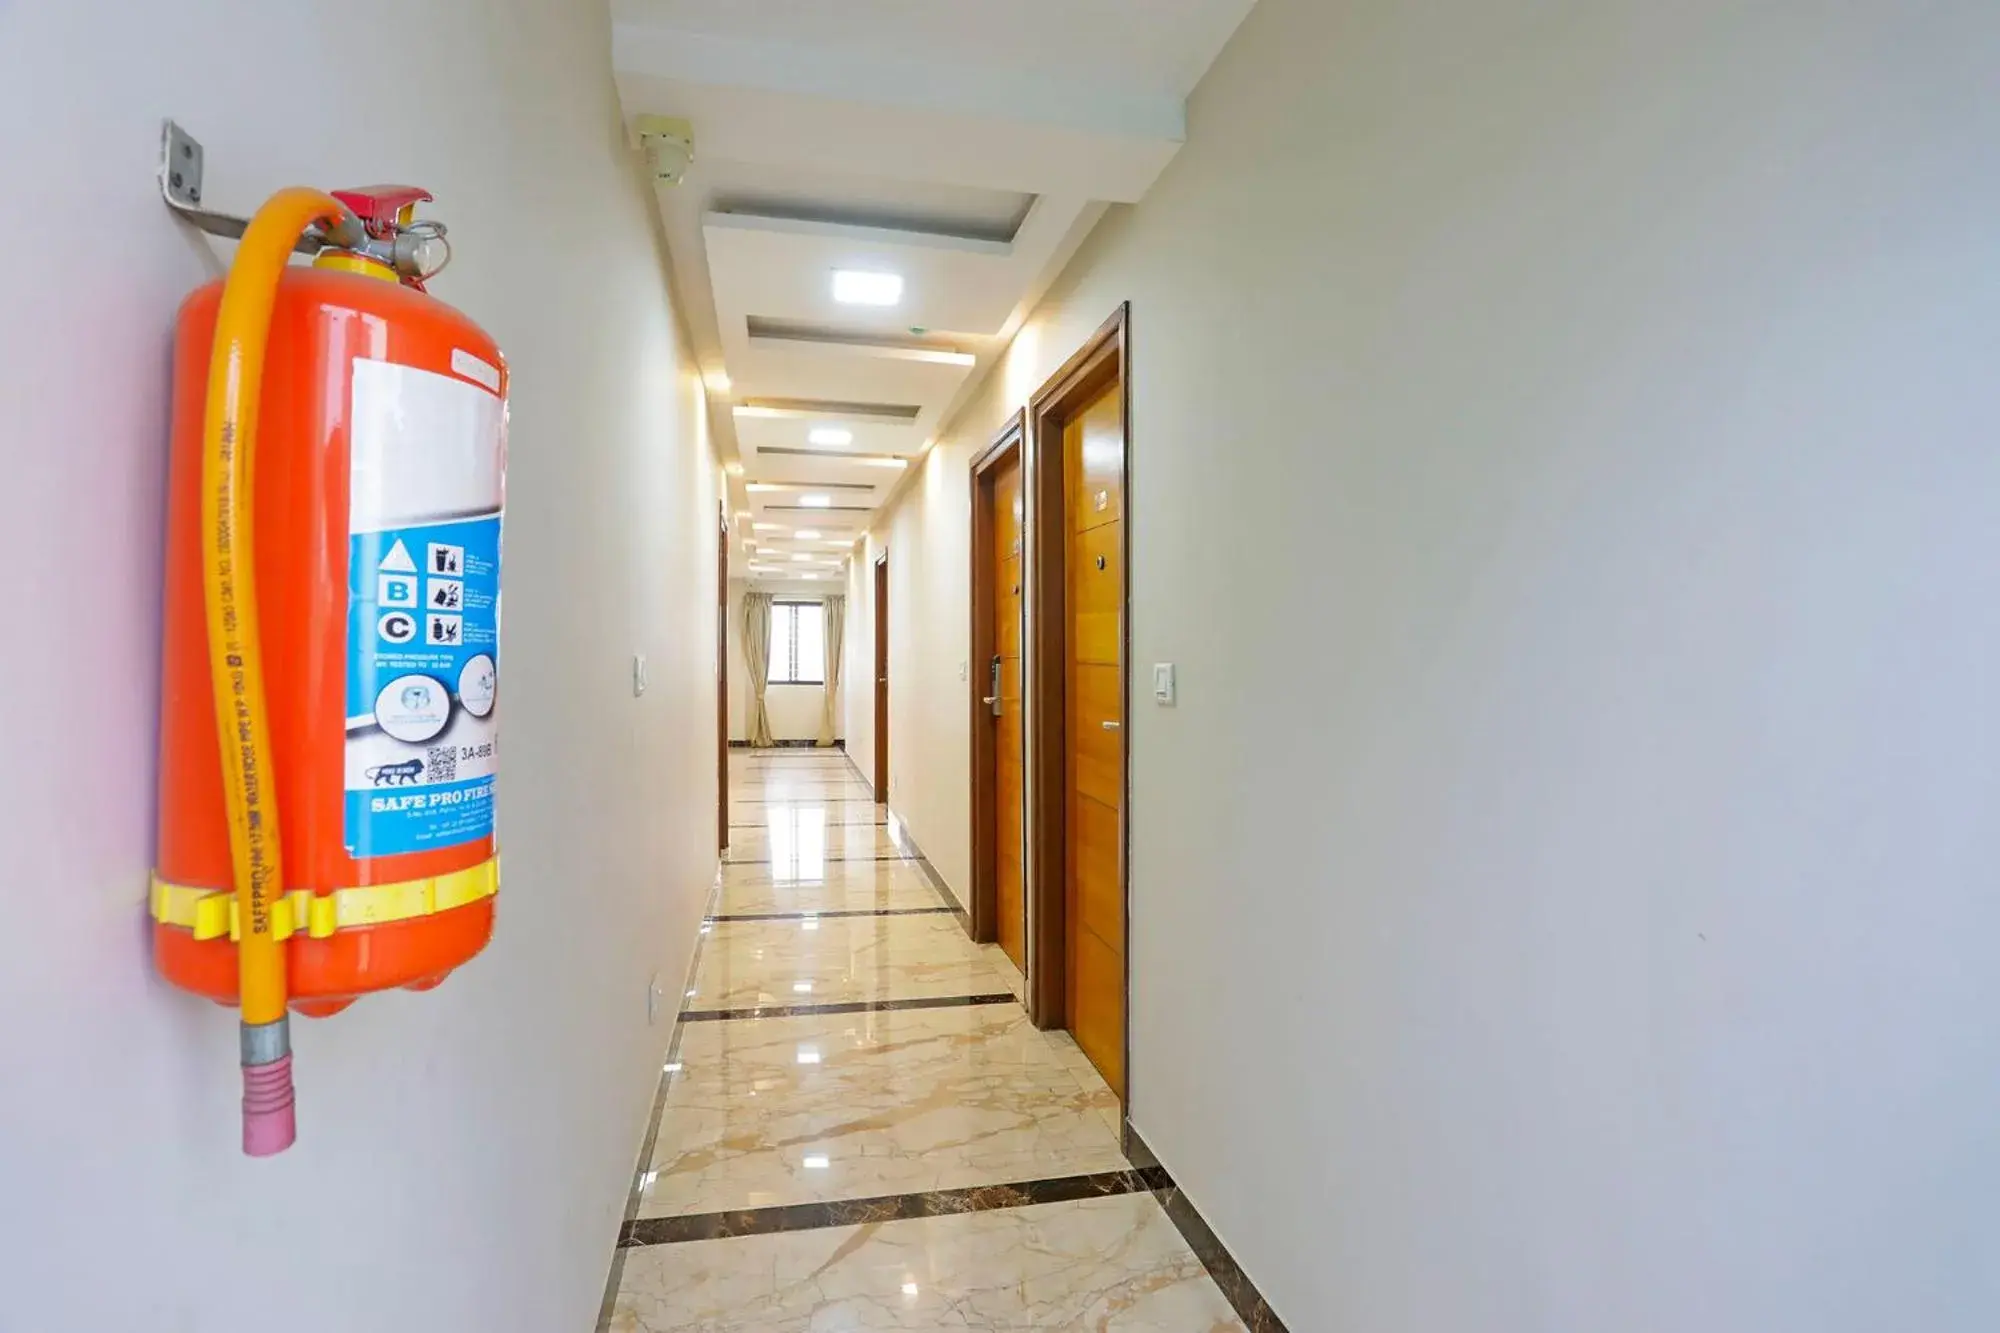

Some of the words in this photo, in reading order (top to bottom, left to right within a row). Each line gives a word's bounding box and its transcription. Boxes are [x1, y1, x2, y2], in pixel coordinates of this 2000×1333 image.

[387, 581, 409, 601] B
[385, 617, 409, 638] C
[371, 794, 426, 812] SAFE
[429, 790, 462, 807] PRO
